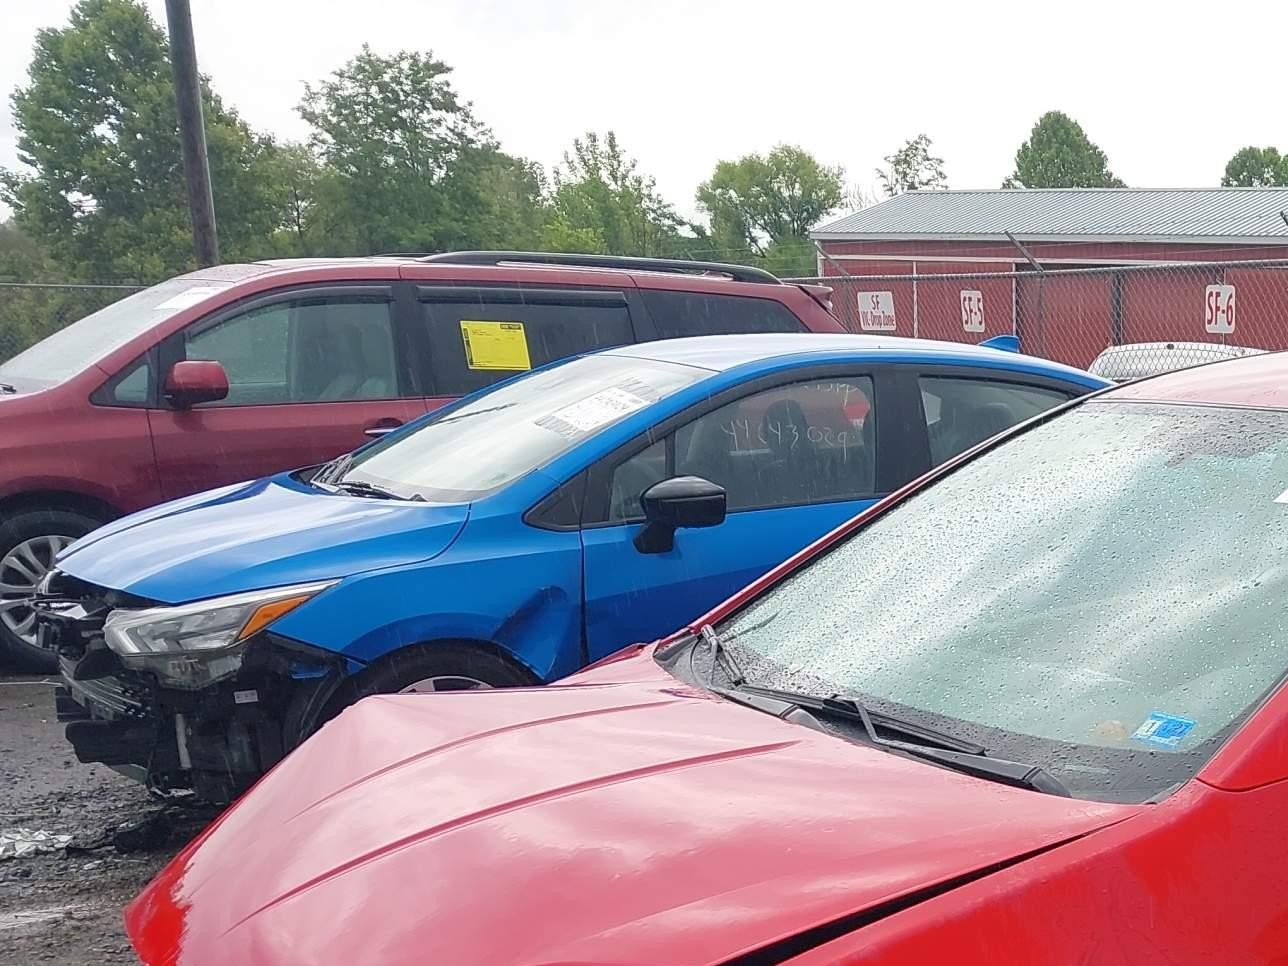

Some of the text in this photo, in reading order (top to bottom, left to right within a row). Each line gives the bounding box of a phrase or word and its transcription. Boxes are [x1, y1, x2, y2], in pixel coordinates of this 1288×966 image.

[871, 294, 880, 310] SF
[963, 296, 983, 326] SF-5
[1207, 291, 1233, 326] SF-6
